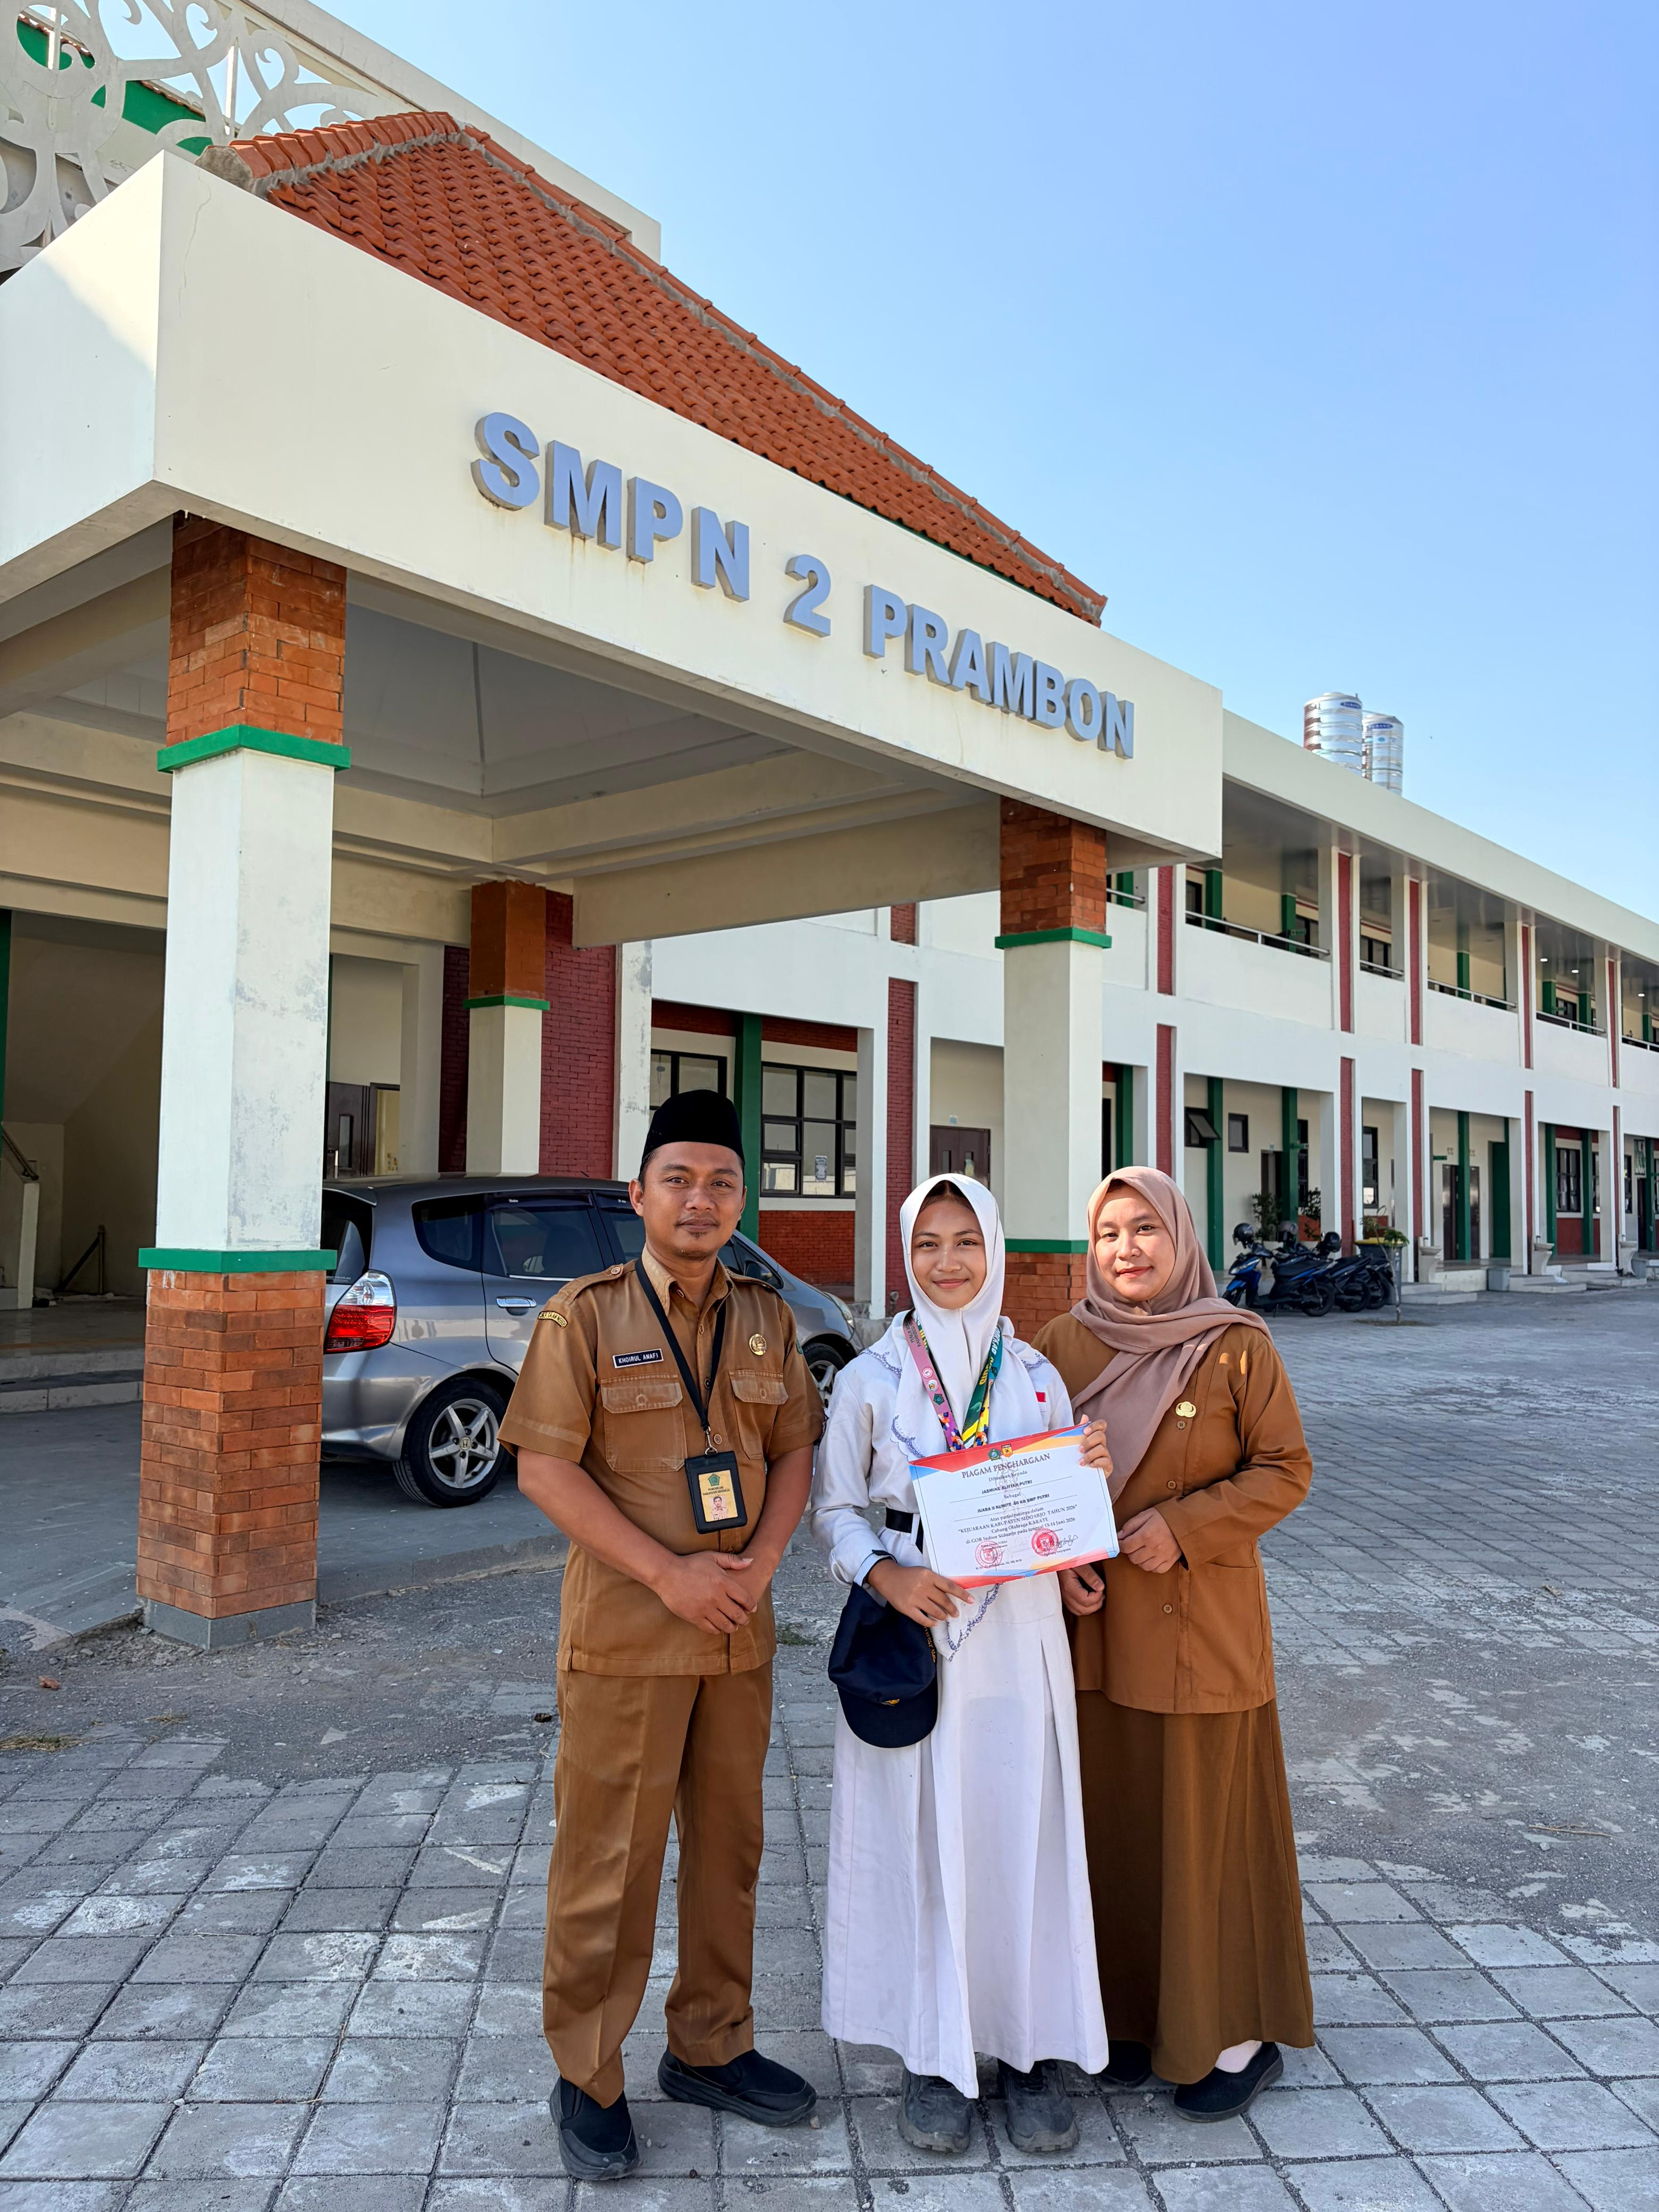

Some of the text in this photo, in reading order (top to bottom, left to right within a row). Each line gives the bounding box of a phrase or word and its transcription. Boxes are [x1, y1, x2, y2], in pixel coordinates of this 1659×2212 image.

[471, 412, 1134, 760] SMPN 2 PRAMBON
[618, 1355, 641, 1364] KHOIRUL
[961, 1453, 1051, 1478] PIAGAM PENGHARGAAN
[990, 1518, 1020, 1528] KABUPATEN
[1021, 1512, 1046, 1521] SIDOARJO
